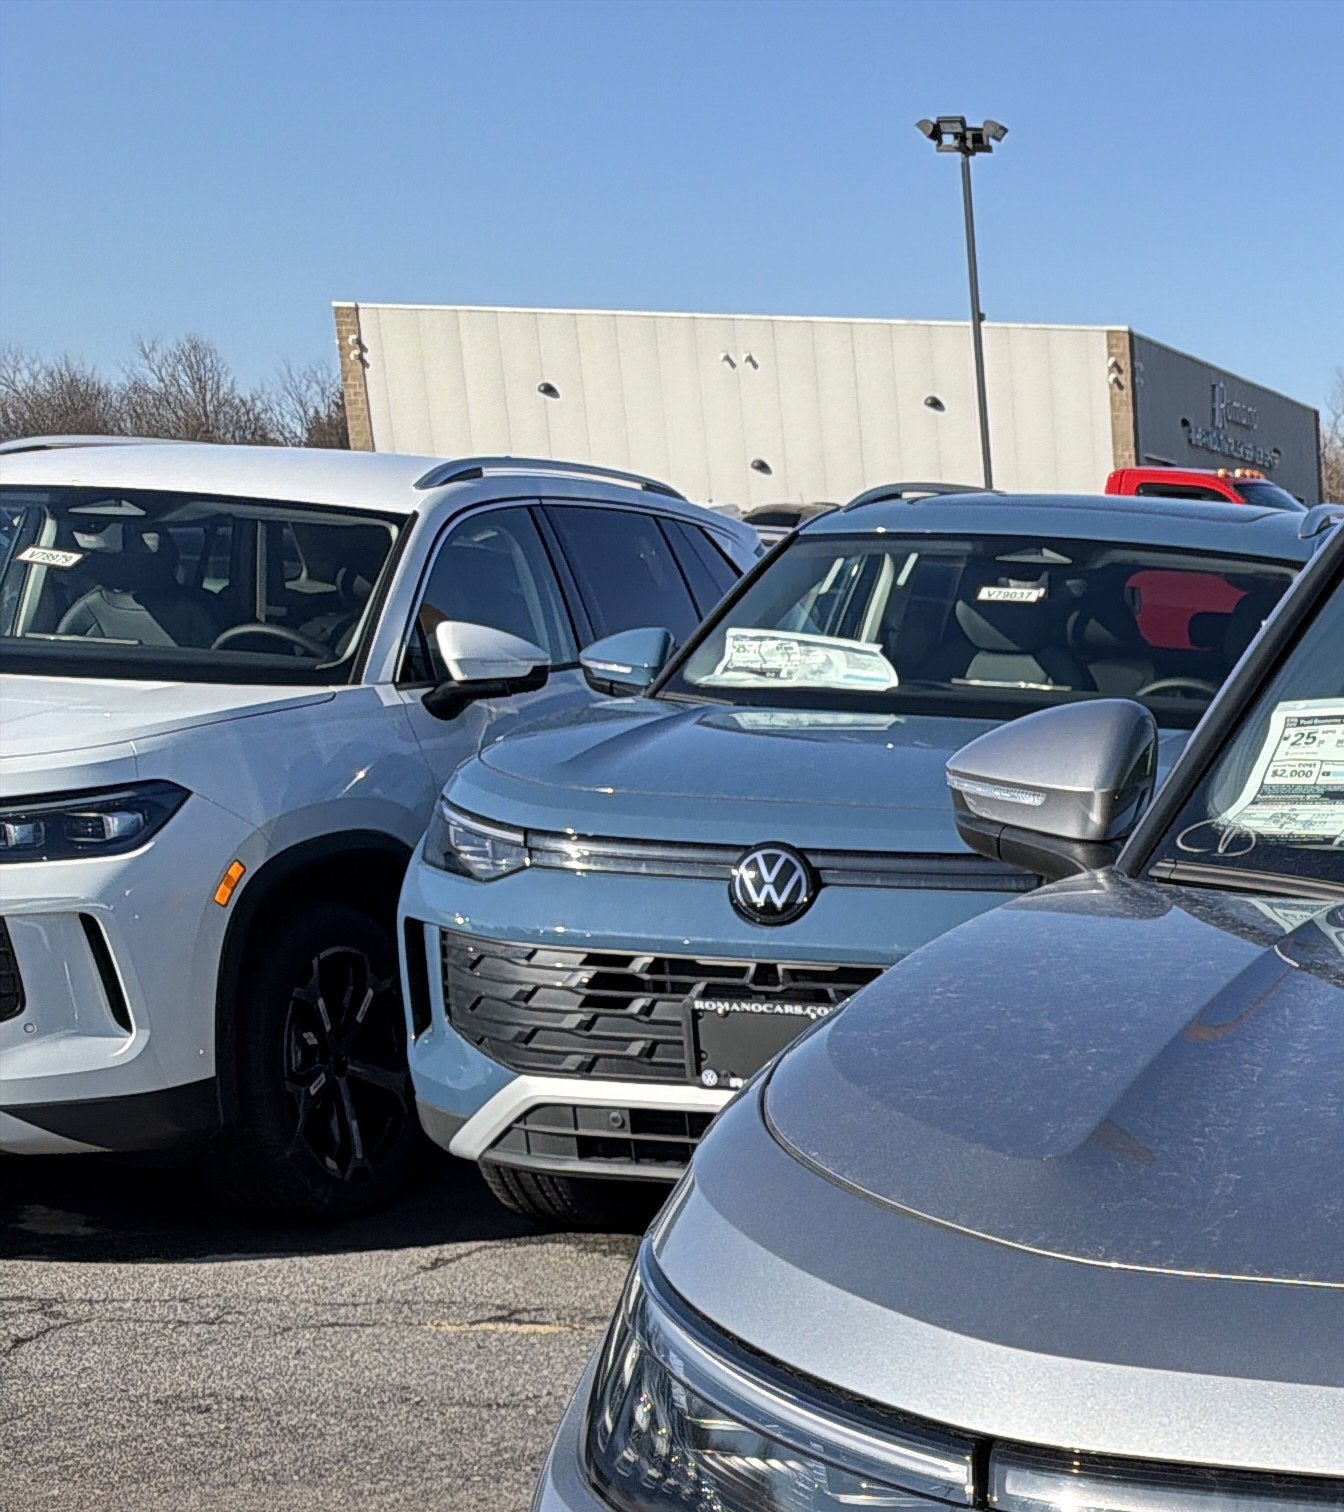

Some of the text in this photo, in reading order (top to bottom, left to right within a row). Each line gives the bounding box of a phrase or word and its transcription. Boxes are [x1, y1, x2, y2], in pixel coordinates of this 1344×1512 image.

[1290, 730, 1317, 747] 25
[1271, 769, 1313, 779] $2,000
[694, 1001, 834, 1017] ROMANOCARS.CO
